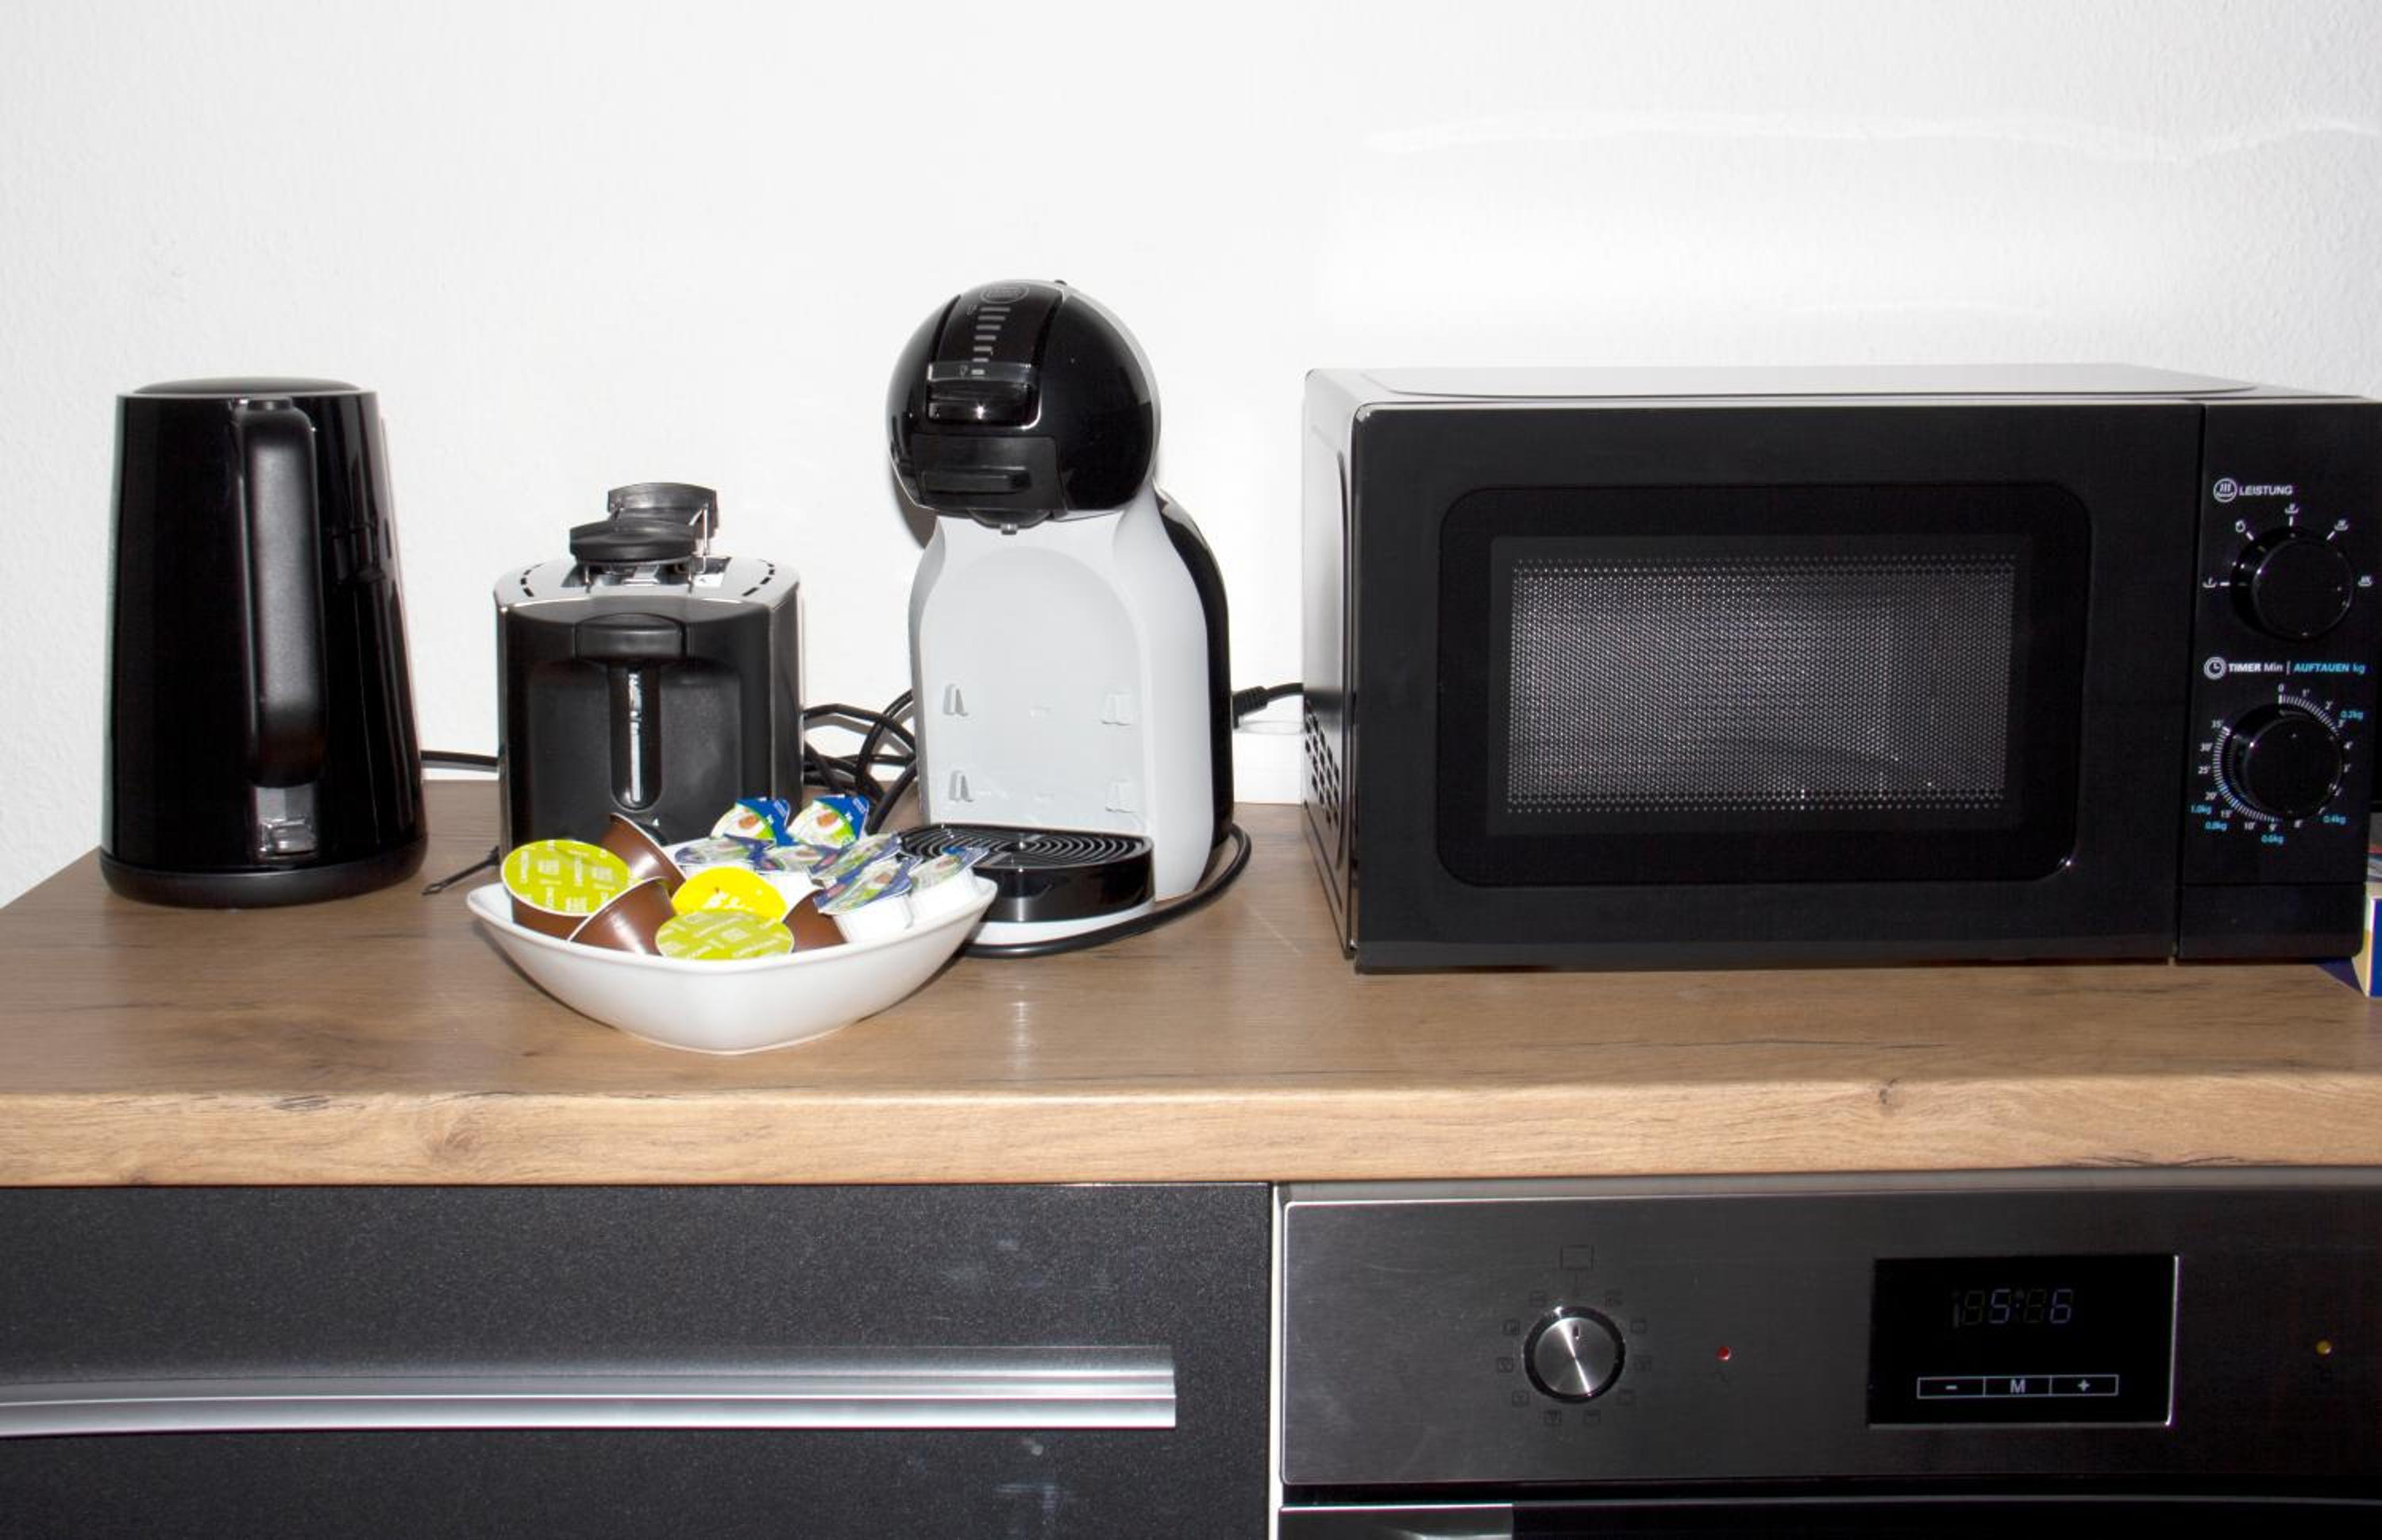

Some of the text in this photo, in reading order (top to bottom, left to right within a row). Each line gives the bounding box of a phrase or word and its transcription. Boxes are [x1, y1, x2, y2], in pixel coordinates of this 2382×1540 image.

[2239, 485, 2293, 496] LEISTUNG
[2228, 663, 2365, 674] TIMER Min AUFTAUEN kg
[2010, 1379, 2026, 1393] M
